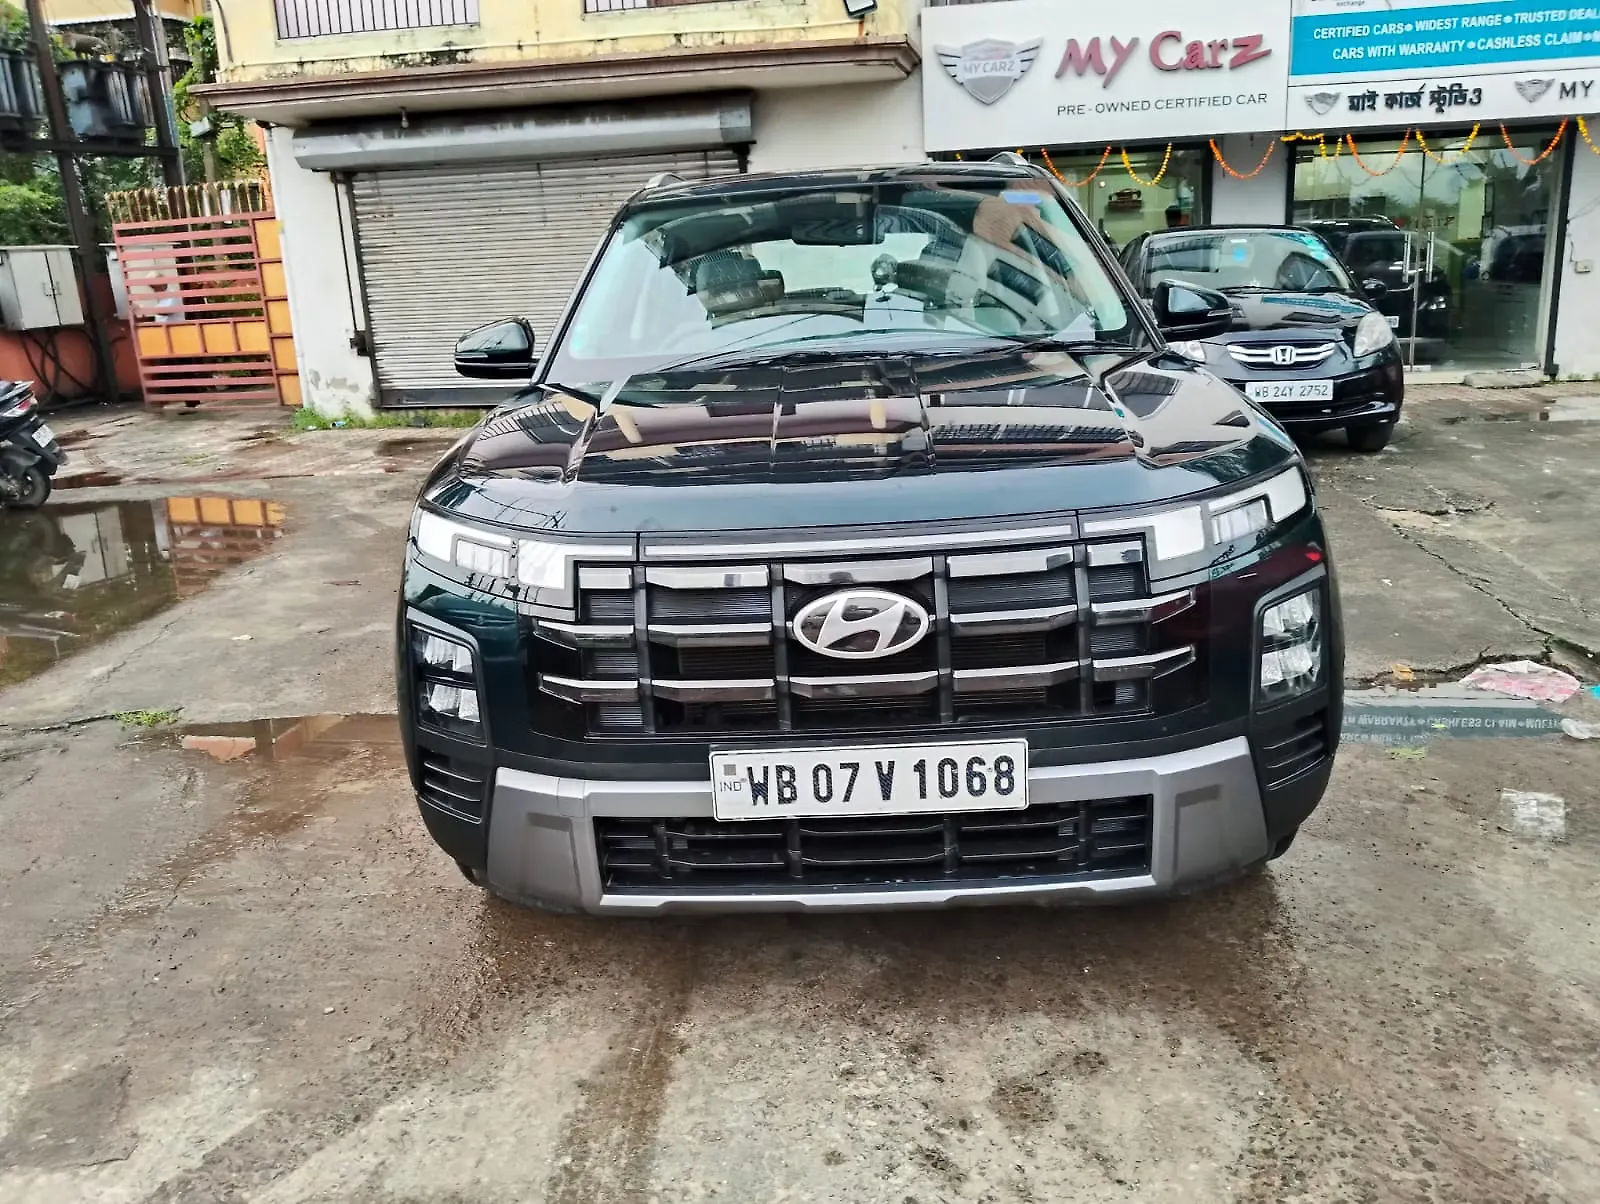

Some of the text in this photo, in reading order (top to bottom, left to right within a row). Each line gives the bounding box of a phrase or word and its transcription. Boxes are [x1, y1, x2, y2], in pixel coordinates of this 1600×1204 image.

[1313, 7, 1600, 40] CERTIFIED CARS WIDEST RANGE TRUSTED DEAL
[1150, 30, 1273, 72] Carz
[1333, 47, 1364, 60] CARS
[1367, 44, 1396, 58] WITH
[1399, 40, 1465, 56] WARRANTY
[1477, 35, 1541, 50] CASHLESS
[1544, 31, 1583, 46] CLAIM
[962, 60, 1016, 74] MY CARZ
[1559, 79, 1595, 100] MY
[1154, 94, 1232, 111] CERTIFIED
[1236, 93, 1268, 106] CAR
[1255, 386, 1269, 398] WB
[1299, 384, 1329, 397] 2752
[719, 781, 742, 792] IND
[747, 755, 1016, 806] WB 07 V 1068
